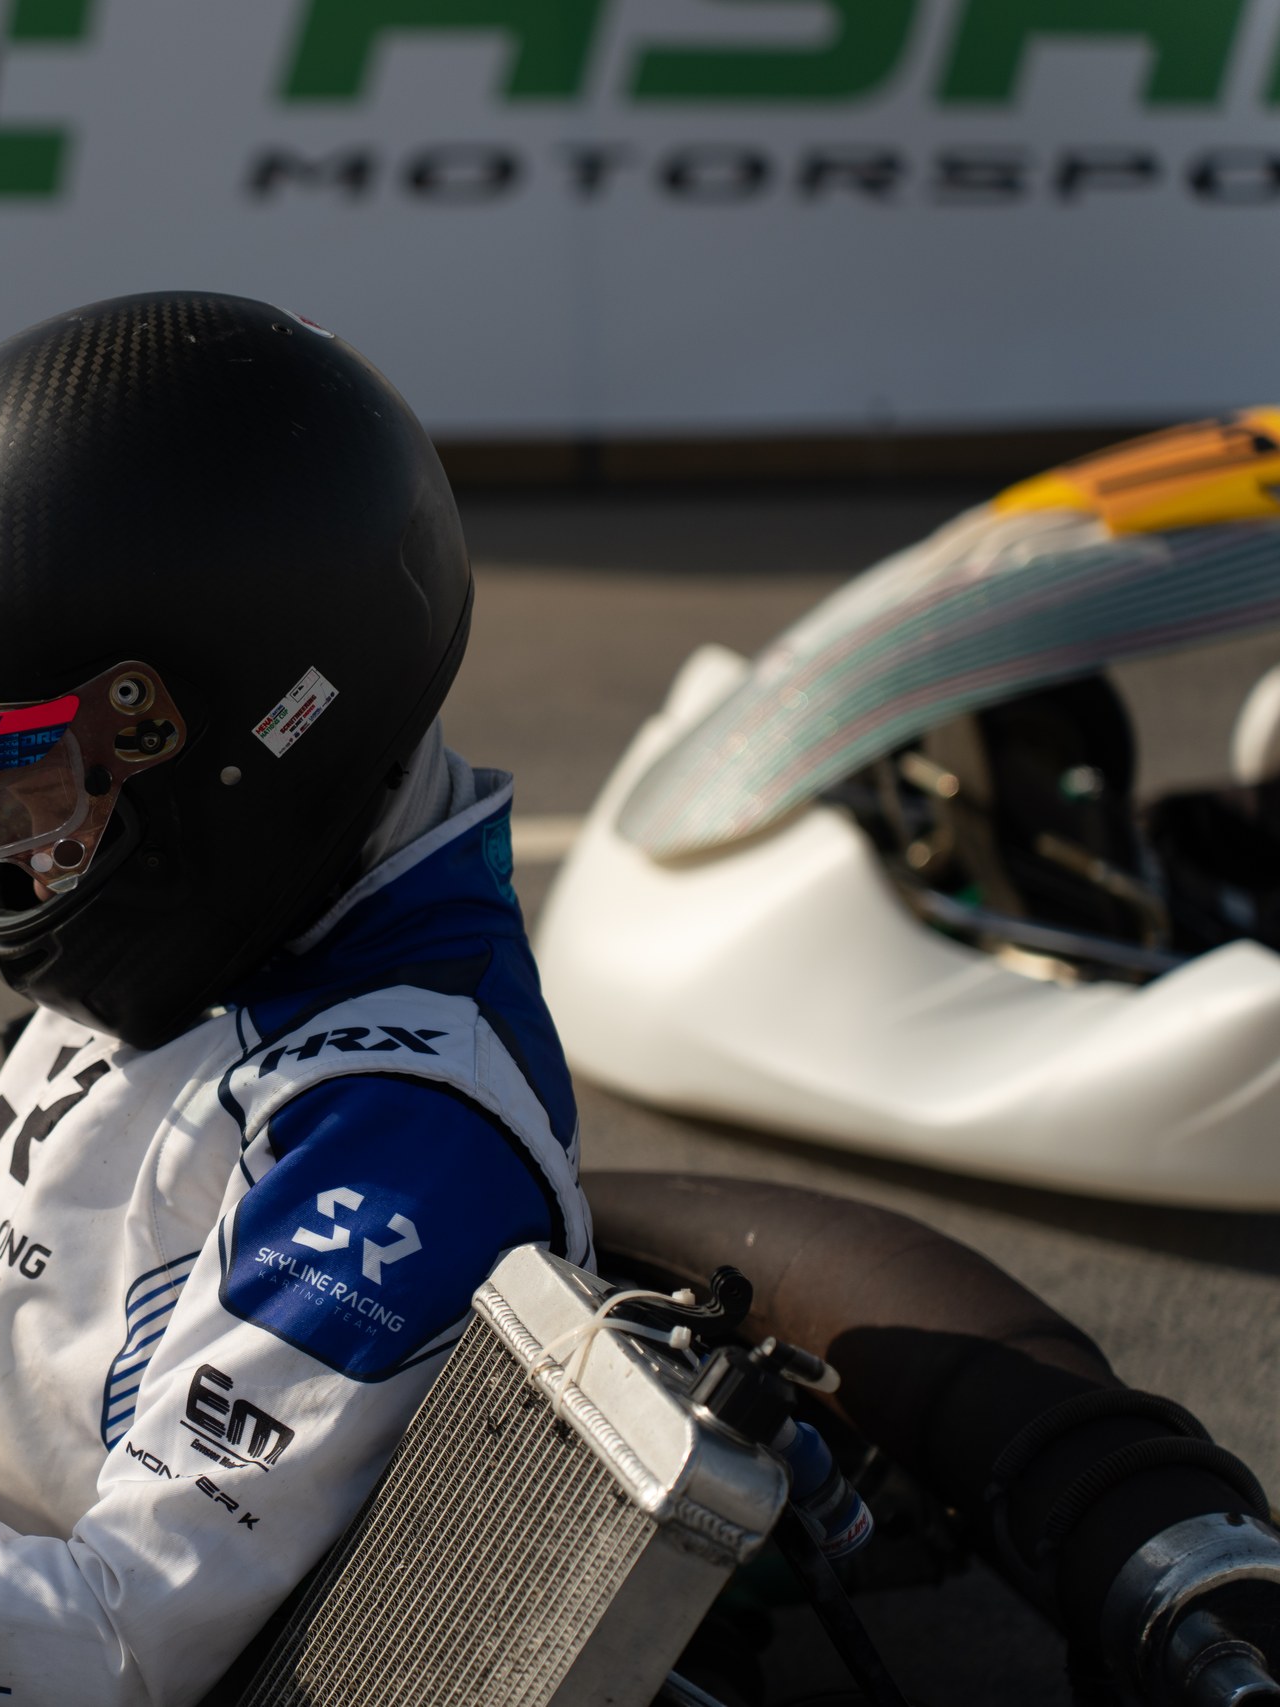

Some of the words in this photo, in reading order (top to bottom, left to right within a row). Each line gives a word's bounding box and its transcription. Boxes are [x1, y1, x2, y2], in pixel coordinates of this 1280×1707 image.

[258, 1026, 450, 1078] HRX
[255, 1247, 333, 1292] SKYLINE
[329, 1282, 406, 1332] RACING
[258, 1271, 325, 1306] KARTING
[335, 1305, 378, 1337] TEAM
